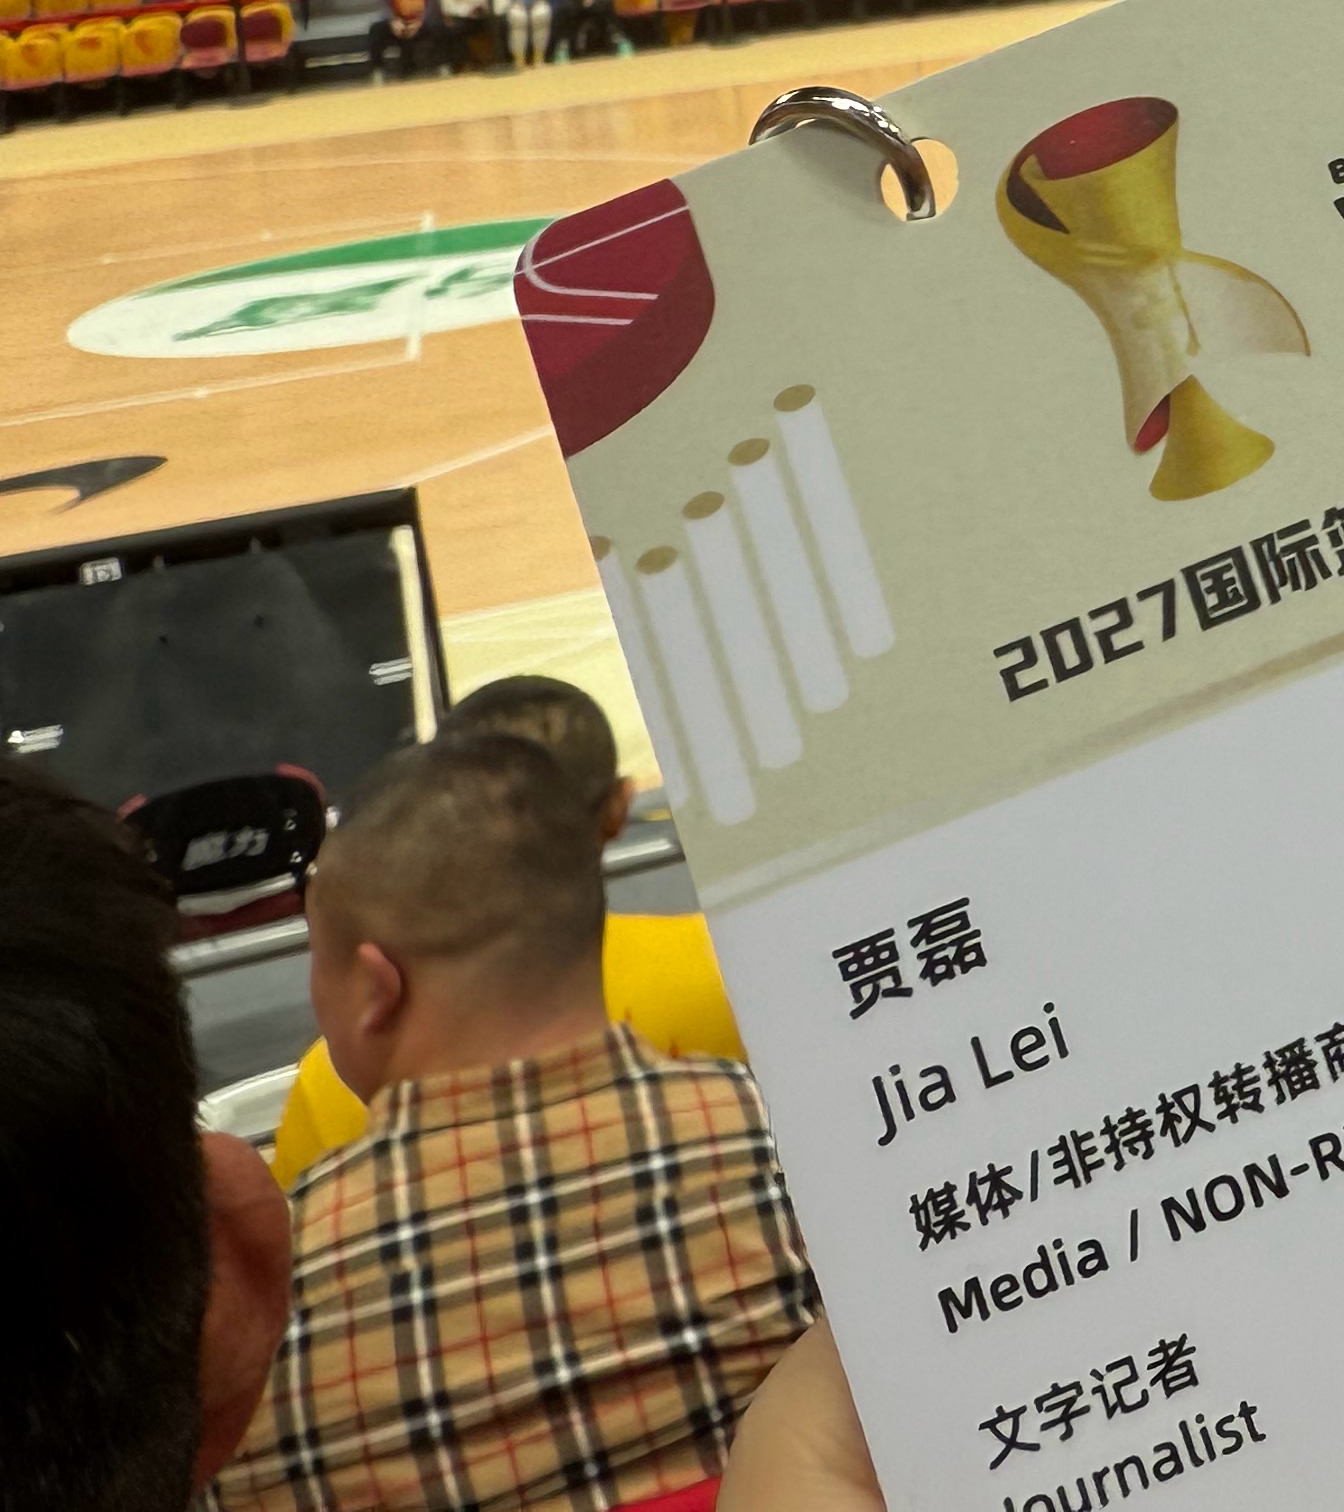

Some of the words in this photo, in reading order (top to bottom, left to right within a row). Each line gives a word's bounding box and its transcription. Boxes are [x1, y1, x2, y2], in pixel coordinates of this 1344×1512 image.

[832, 897, 988, 1020] 贾磊
[872, 1065, 957, 1147] Jia
[970, 1001, 1069, 1089] Lei
[937, 1238, 1110, 1334] Media
[1129, 1208, 1140, 1263] /
[978, 1332, 1200, 1471] 文字记者
[1003, 1400, 1267, 1512] urnalist
